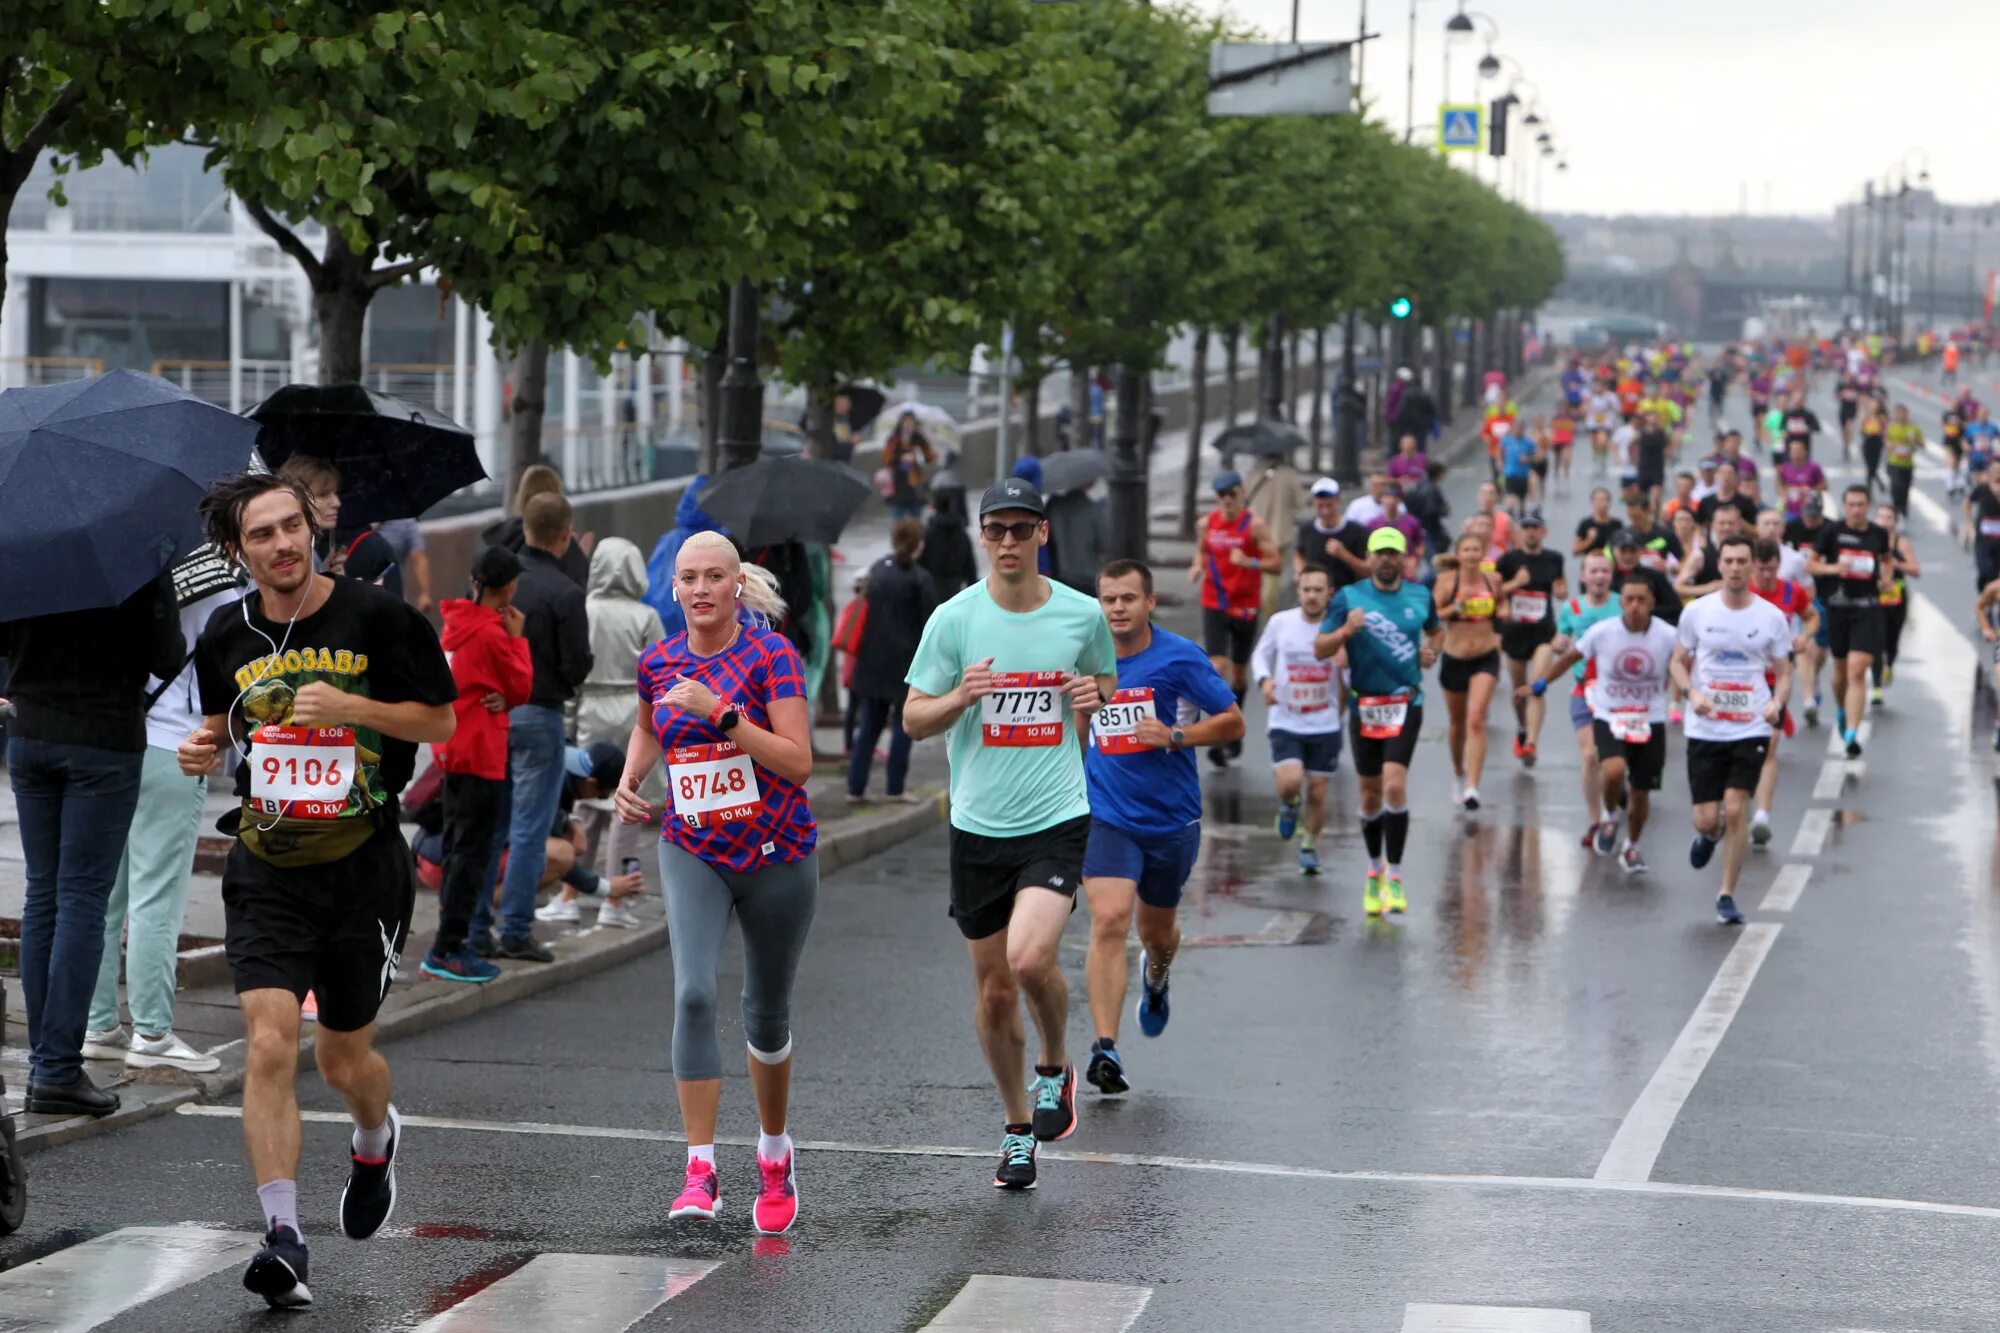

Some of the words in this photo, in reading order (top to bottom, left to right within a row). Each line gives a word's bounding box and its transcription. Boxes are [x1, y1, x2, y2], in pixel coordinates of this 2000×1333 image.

[234, 647, 368, 692] ПИВОЗАВР
[992, 690, 1052, 714] 7773
[1012, 715, 1037, 723] АРТУР
[1099, 705, 1146, 727] 8510
[319, 728, 344, 738] 8.08
[1027, 727, 1039, 737] 10
[1127, 736, 1138, 744] 10
[716, 741, 737, 752] 8.08
[262, 757, 342, 787] 9106
[680, 768, 746, 800] 8748
[305, 804, 321, 815] 10
[719, 811, 733, 821] 10
